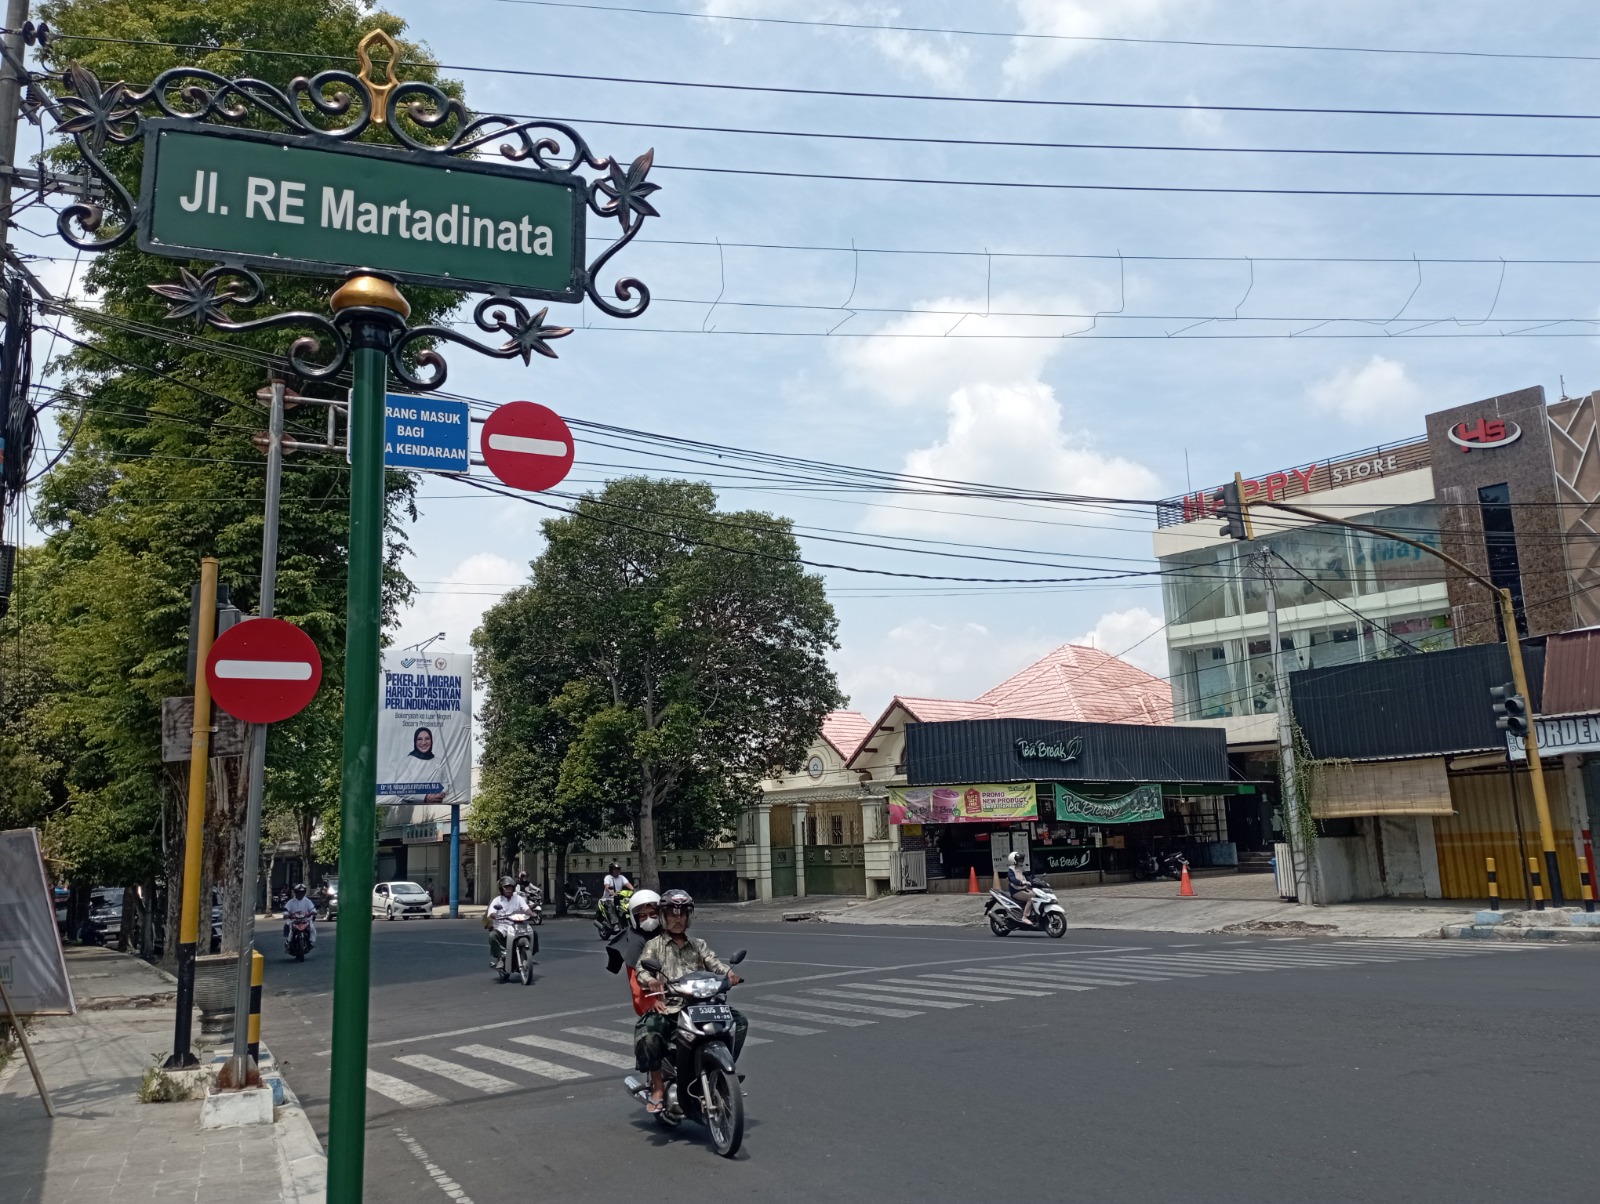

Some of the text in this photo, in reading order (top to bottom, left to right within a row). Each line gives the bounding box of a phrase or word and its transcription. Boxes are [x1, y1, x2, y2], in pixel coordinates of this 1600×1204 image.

[179, 169, 554, 257] Jl. RE Martadinata
[385, 406, 461, 425] RANG MASUK
[397, 425, 424, 438] BAGI
[396, 443, 466, 460] KENDARAAN
[1332, 456, 1398, 483] STORE
[385, 673, 461, 689] PEKERJA MIGRAN
[385, 685, 461, 700] HARUS DIPASTIKAN
[385, 698, 461, 712] PERLINDUNGANNYA
[1515, 717, 1600, 751] ORDEN
[1018, 740, 1067, 758] Tea Break
[1061, 793, 1117, 817] Tea Break
[1047, 855, 1079, 868] Tea Break
